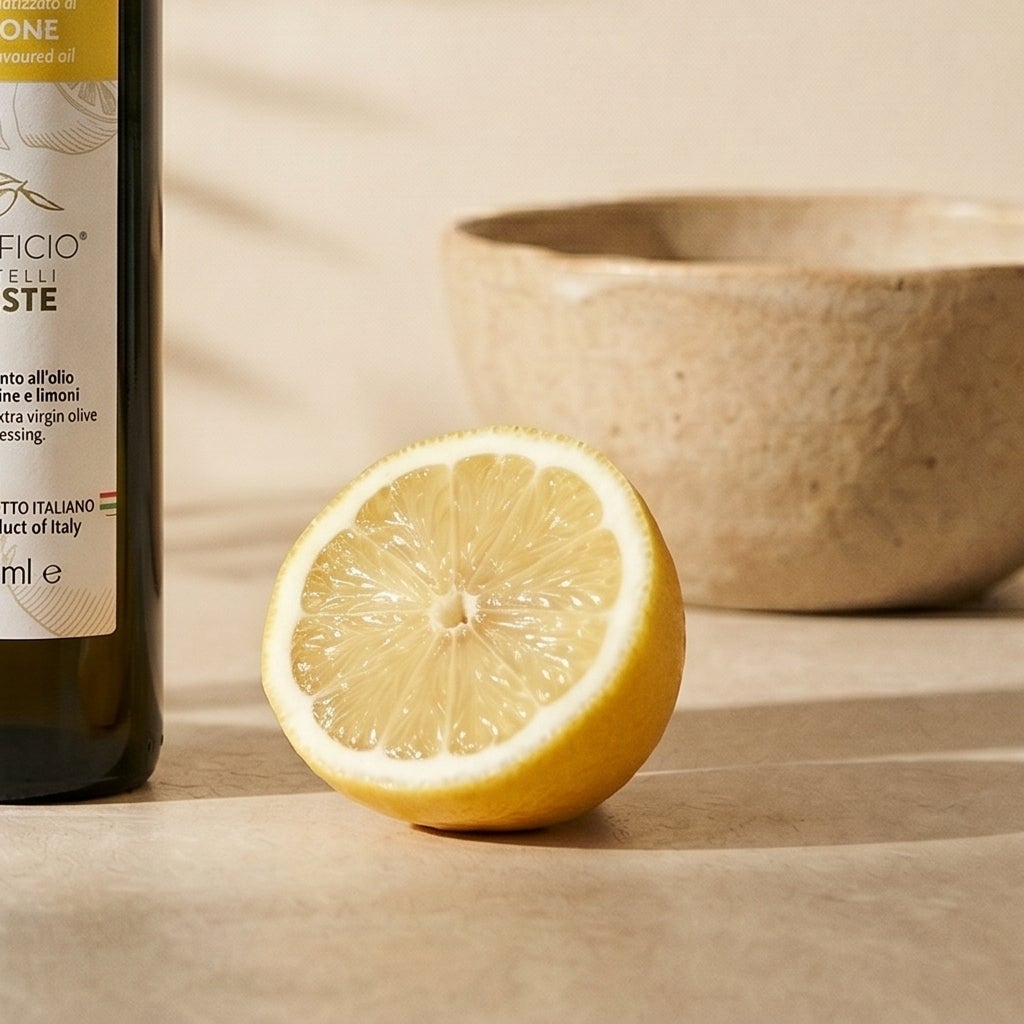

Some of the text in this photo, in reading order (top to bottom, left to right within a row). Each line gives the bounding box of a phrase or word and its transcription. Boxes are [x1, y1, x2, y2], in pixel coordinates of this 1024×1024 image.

[59, 48, 76, 64] oil
[28, 370, 74, 385] all'olio
[24, 392, 32, 403] e
[36, 388, 80, 403] limoni
[27, 409, 65, 427] virgin
[68, 408, 98, 422] olive
[33, 499, 95, 514] ITALIANO
[32, 519, 48, 535] of
[51, 520, 82, 538] Italy
[2, 558, 32, 585] ml
